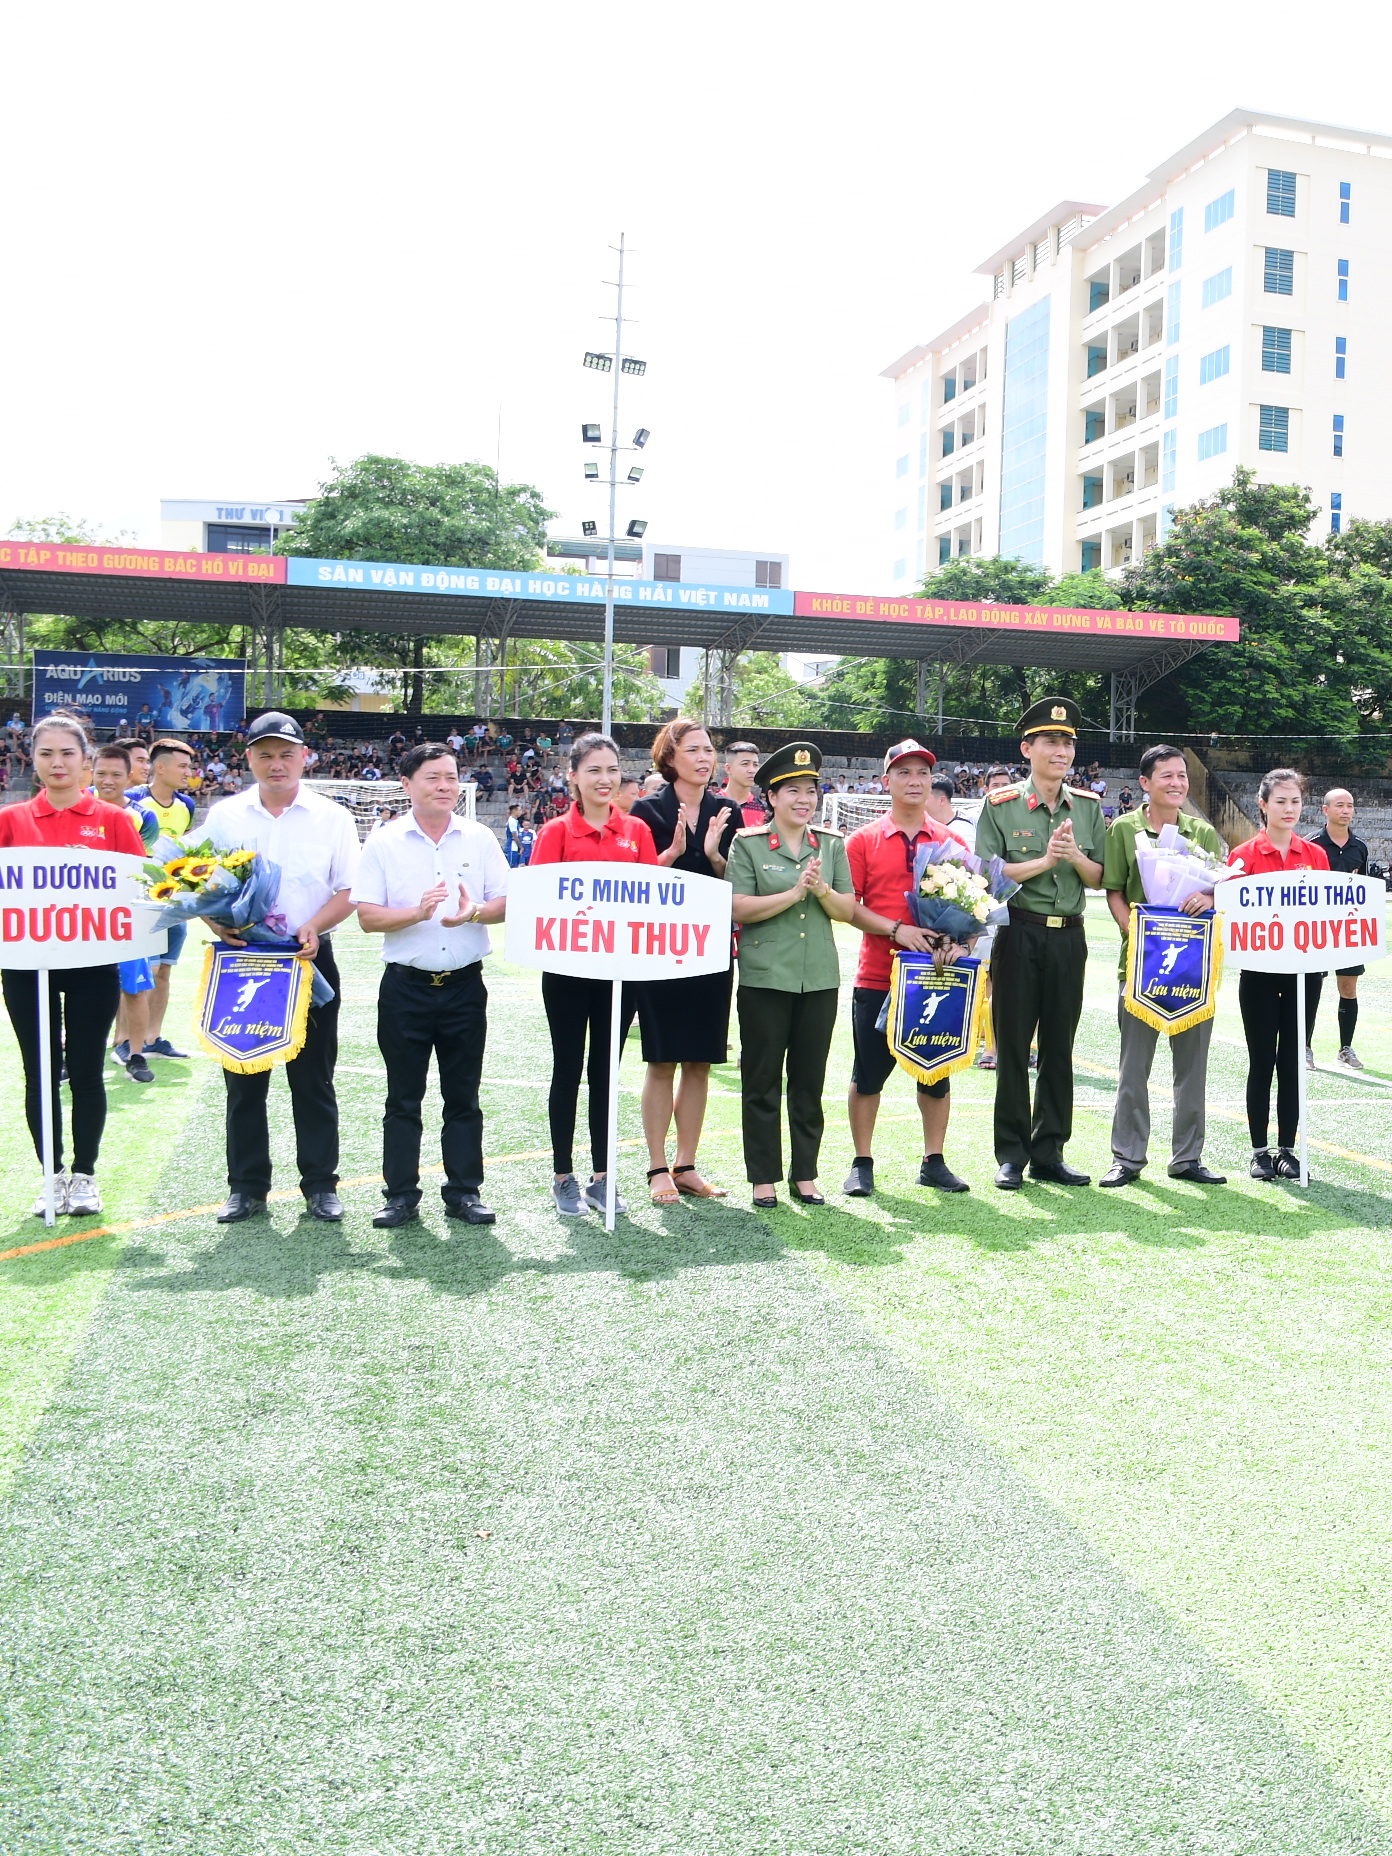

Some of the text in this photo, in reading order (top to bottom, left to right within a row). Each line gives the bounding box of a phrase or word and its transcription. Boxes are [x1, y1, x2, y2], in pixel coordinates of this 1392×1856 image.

[250, 507, 284, 522] VIN
[19, 547, 51, 566] TẬP
[57, 551, 98, 568] THEO
[103, 553, 159, 571] GƯƠNG
[165, 555, 197, 574] BÁC
[202, 557, 223, 575] HỒ
[228, 560, 243, 576] VĨ
[248, 562, 275, 580] ĐẠI
[318, 565, 364, 583] SÂN
[370, 568, 414, 587] VẬN
[421, 571, 479, 590] ĐỘNG
[486, 576, 521, 594] ĐẠI
[528, 579, 569, 597] HỌC
[639, 584, 673, 602] HẢI
[679, 588, 718, 606] VIỆT
[724, 592, 769, 608] NAM
[812, 595, 851, 613] KHỎE
[856, 597, 874, 614] ĐỂ
[879, 603, 909, 618] HỌC
[950, 608, 977, 621] LAO
[981, 608, 1019, 624] ĐỘNG
[1024, 611, 1048, 625] XÂY
[1053, 613, 1090, 628] DỰNG
[1096, 615, 1112, 629] VÀ
[1116, 614, 1144, 631] BẢO
[1149, 618, 1165, 634] VỆ
[1189, 619, 1225, 636] QUỐC
[45, 657, 142, 689] AQUARIUS
[44, 691, 72, 705] ĐIỆN
[76, 692, 102, 708] MẠO
[105, 692, 128, 706] MỚI
[33, 863, 117, 890] DƯƠNG
[558, 875, 685, 906] FC MINH VŨ
[1239, 874, 1367, 907] C.TY HIẾU THẢO
[2, 904, 133, 942] DƯƠNG
[535, 905, 711, 965] KIẾN THỤY
[1230, 913, 1284, 952] NGÔ
[1293, 907, 1378, 954] QUYỀN
[1143, 977, 1201, 1000] Lưu niệm
[211, 1016, 283, 1039] Lưu niệm
[903, 1027, 961, 1048] Lưu niệm
